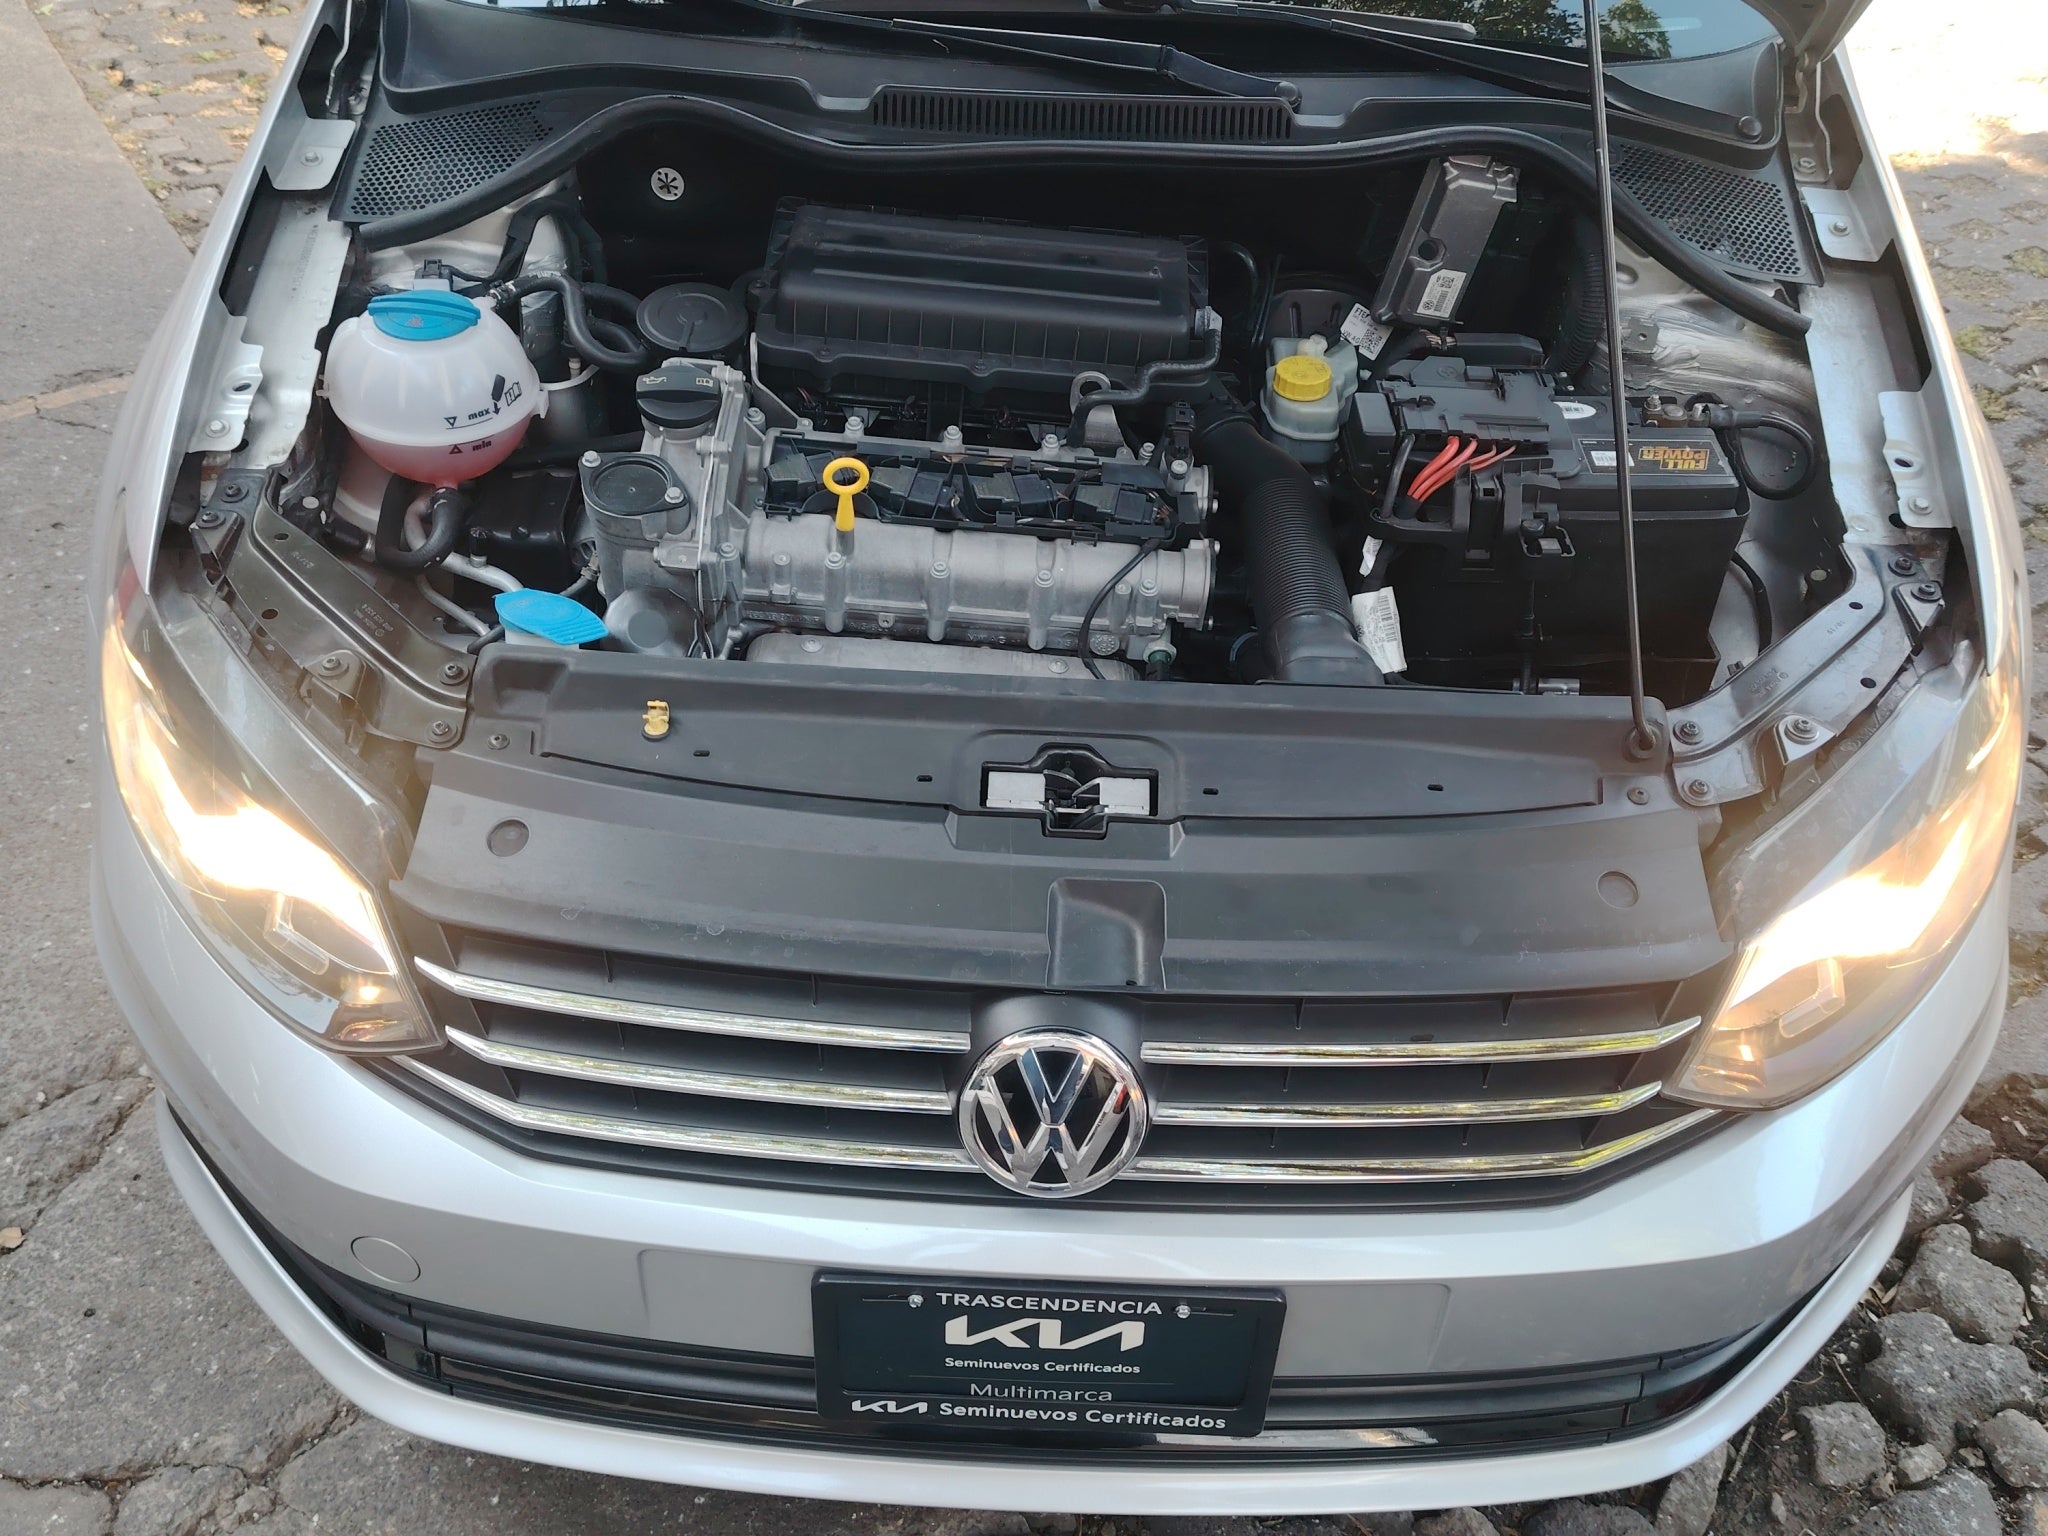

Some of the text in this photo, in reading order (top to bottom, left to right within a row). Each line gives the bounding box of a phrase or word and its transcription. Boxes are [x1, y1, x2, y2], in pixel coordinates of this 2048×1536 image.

[468, 408, 491, 420] max
[473, 440, 492, 451] min
[1642, 449, 1706, 460] POWER
[1665, 460, 1706, 470] FULL
[935, 1292, 1163, 1315] TRASCENDENCIA
[944, 1314, 1145, 1352] KIA
[944, 1357, 1141, 1374] Seminuevos Certificados
[969, 1383, 1113, 1401] Multimarca
[851, 1400, 1226, 1429] KIA Seminuevos Certificados
